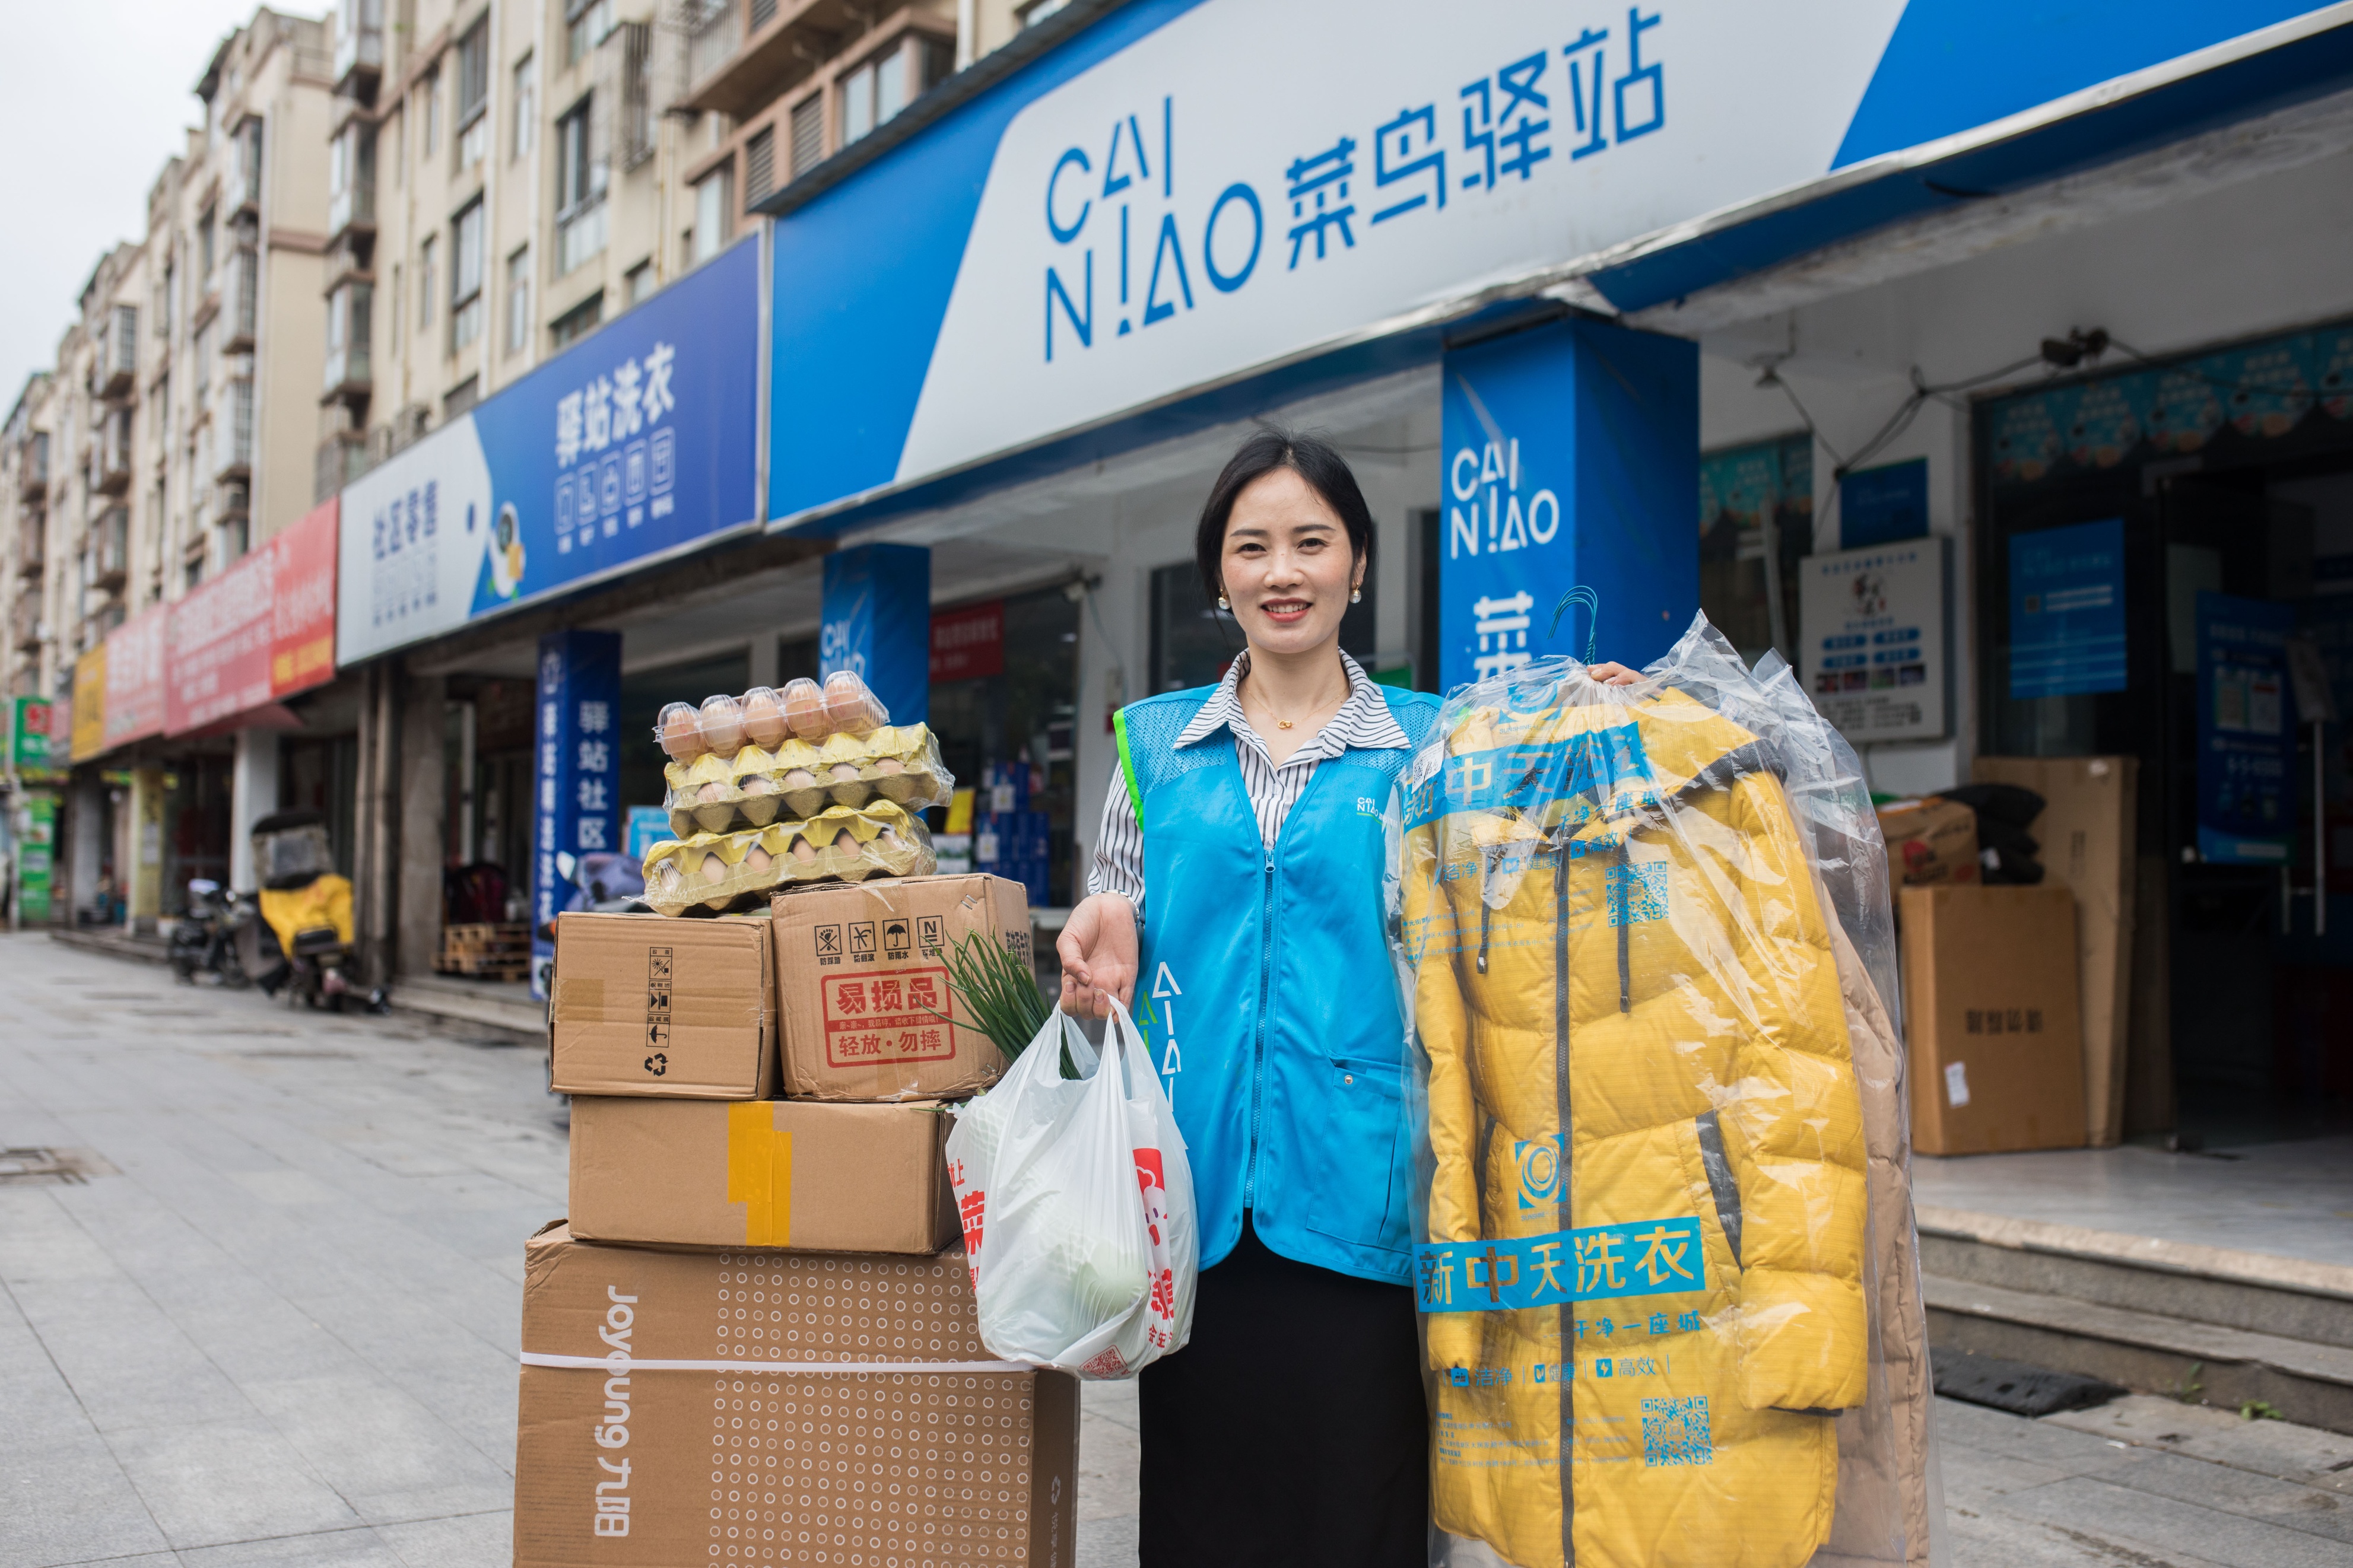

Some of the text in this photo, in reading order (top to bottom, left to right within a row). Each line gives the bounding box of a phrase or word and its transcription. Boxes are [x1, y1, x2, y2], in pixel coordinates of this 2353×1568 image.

[1046, 95, 1172, 244] CAI
[1285, 5, 1665, 272] 菜鸟驿站
[1044, 183, 1263, 363] NIAO
[1451, 438, 1519, 502] CAI
[1450, 485, 1560, 559] NIAO
[1357, 797, 1375, 806] CAI
[820, 956, 841, 966] 防踩踏
[888, 950, 909, 960] 防雨水
[836, 977, 938, 1015] 易损品
[1418, 1226, 1695, 1305] 新中天洗衣
[1573, 1310, 1701, 1340] 干净一座城
[1474, 1356, 1656, 1387] 洁净 健康 高效
[593, 1284, 639, 1538] Joyoung 九阳
